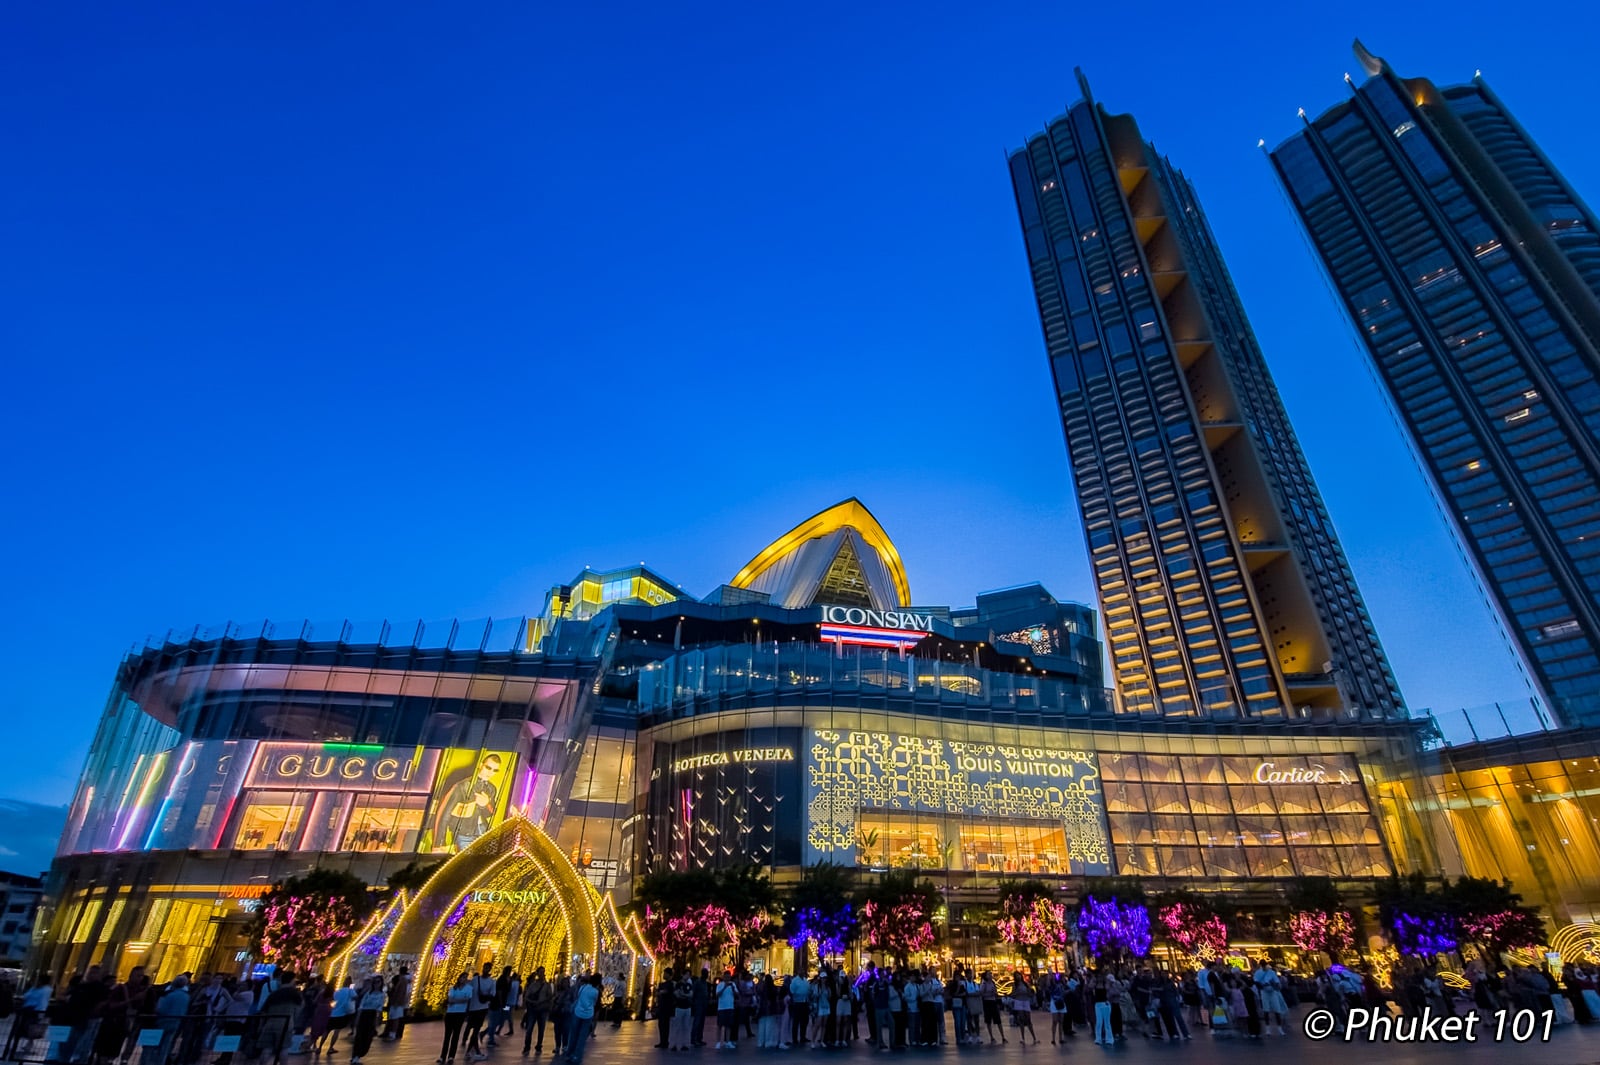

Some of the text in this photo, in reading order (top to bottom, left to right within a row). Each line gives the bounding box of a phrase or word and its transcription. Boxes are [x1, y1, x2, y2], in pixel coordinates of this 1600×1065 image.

[821, 605, 934, 632] ICONSIAM
[278, 754, 413, 781] GUCCI
[674, 748, 794, 773] BOTTEGA VENETA
[957, 756, 1075, 778] LOUIS VUITTON
[1256, 762, 1325, 784] Cartier
[473, 890, 547, 904] ICONSIAM
